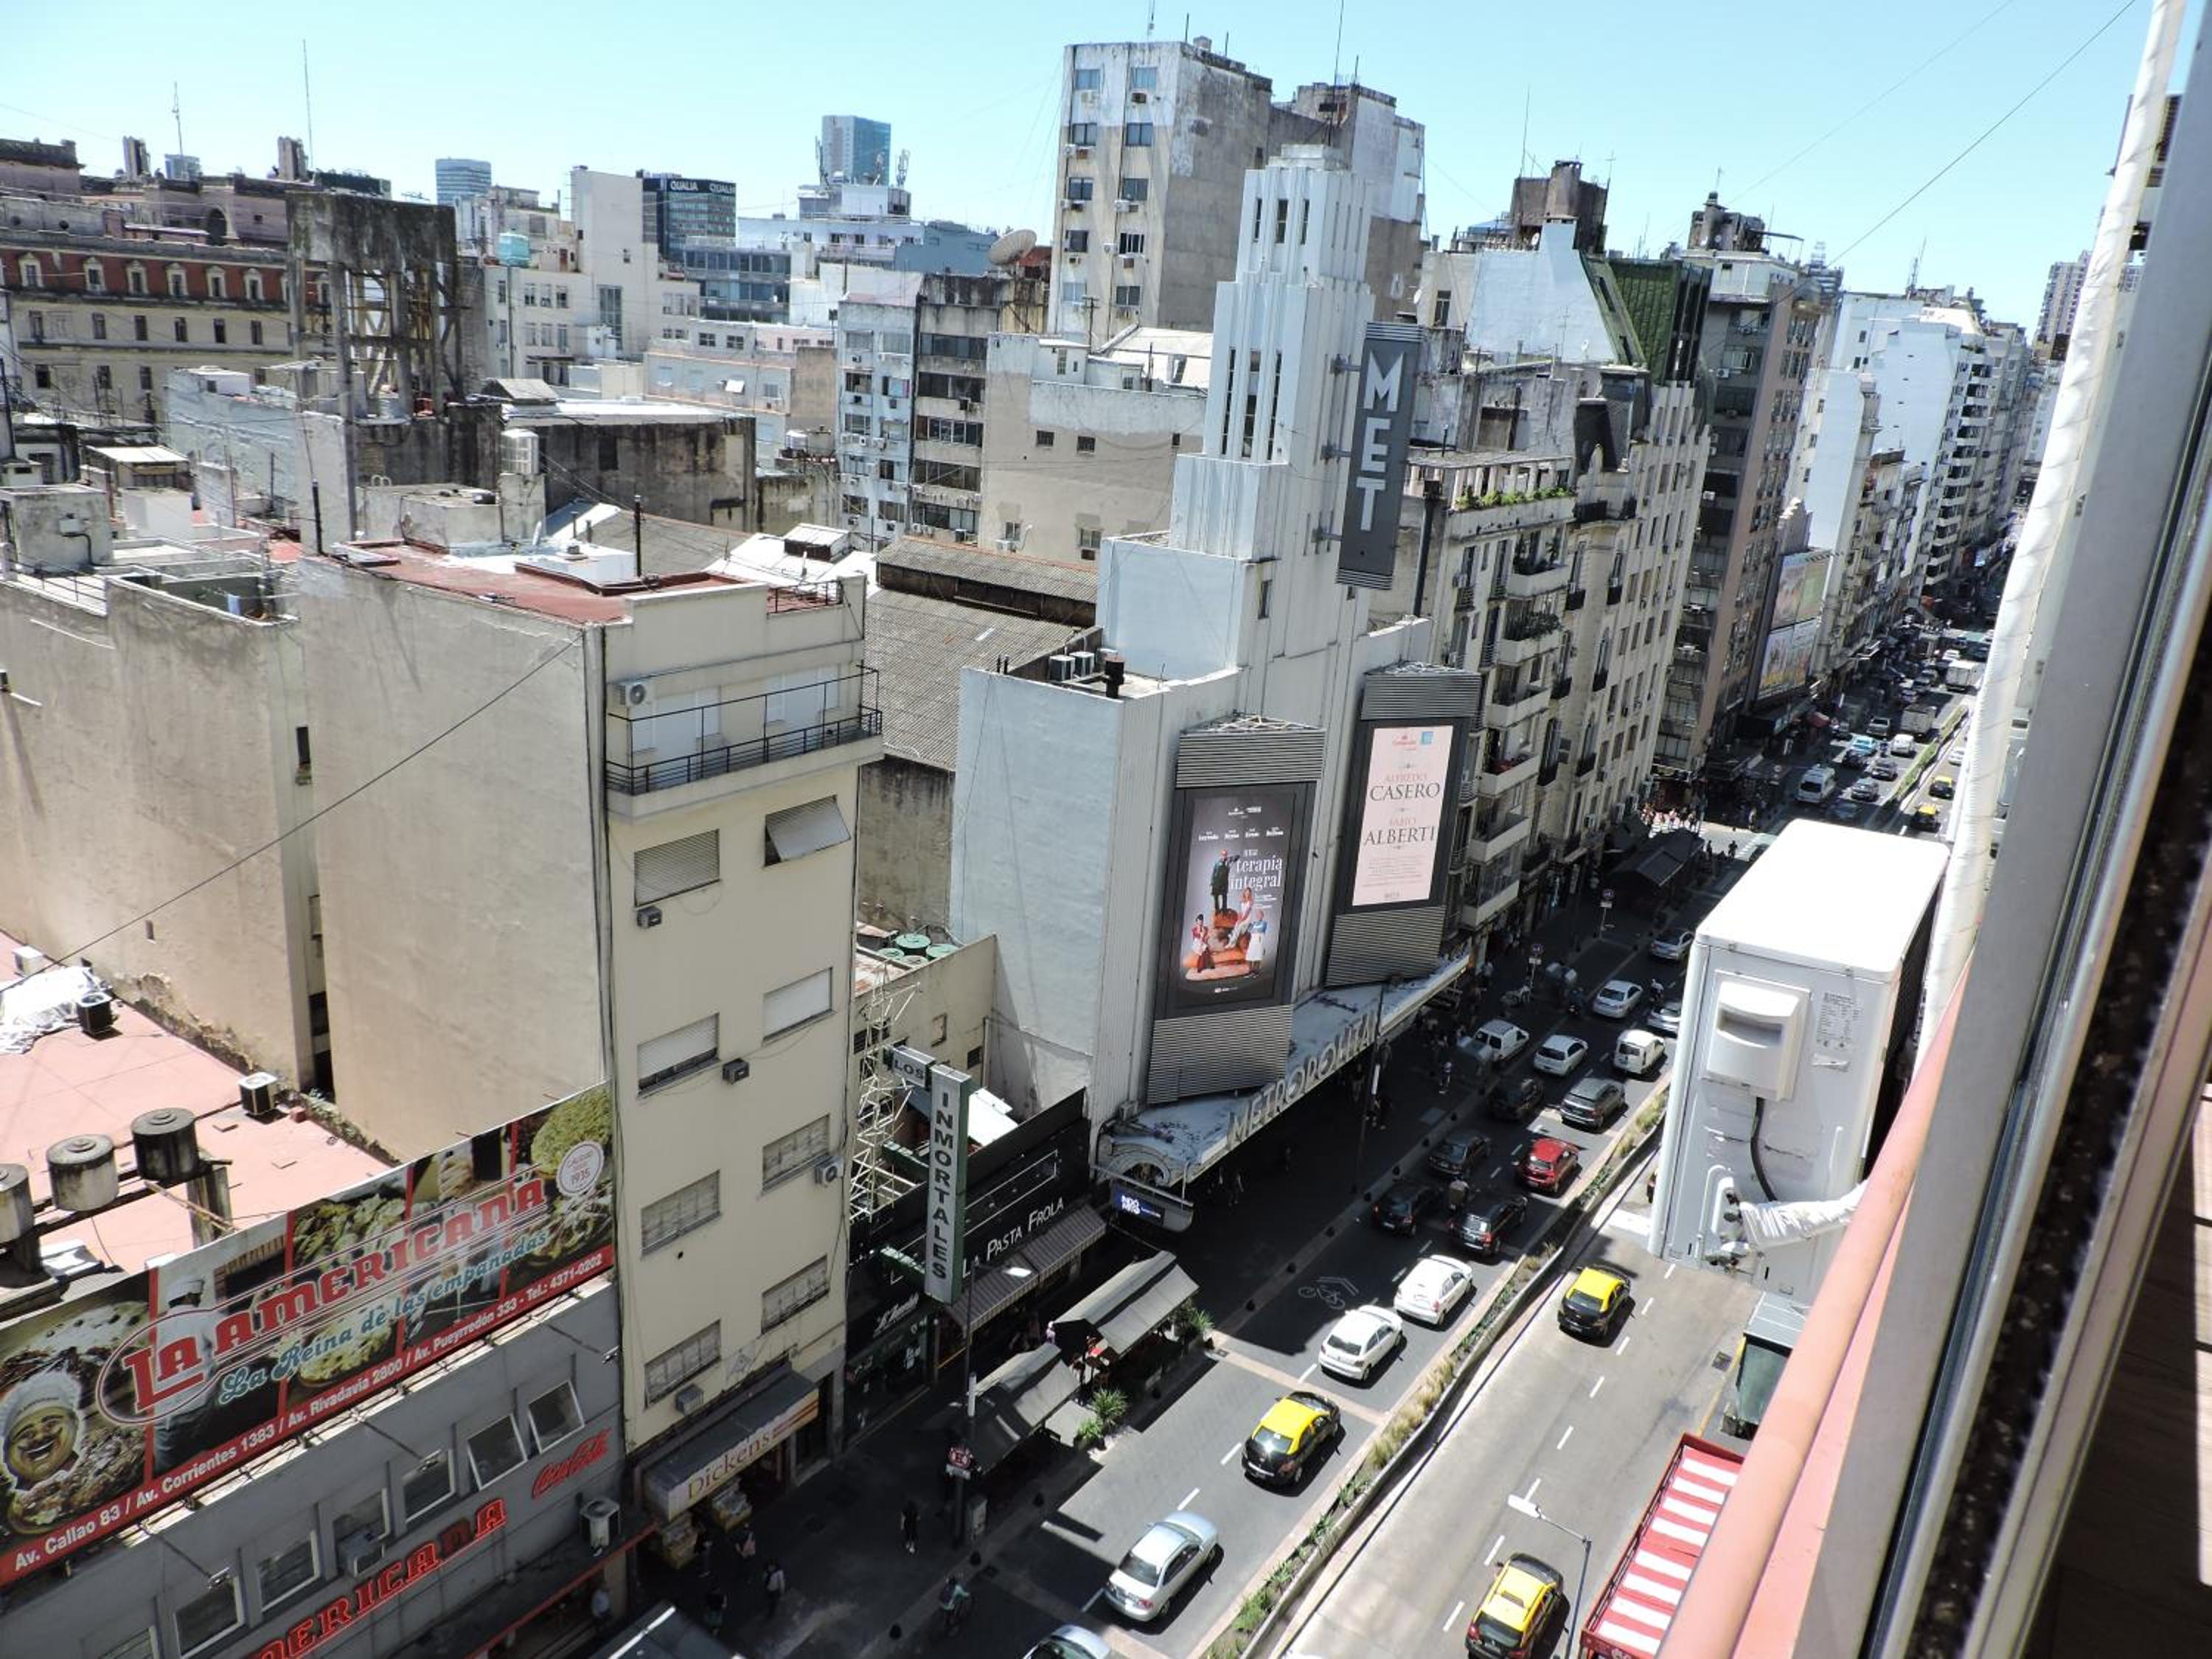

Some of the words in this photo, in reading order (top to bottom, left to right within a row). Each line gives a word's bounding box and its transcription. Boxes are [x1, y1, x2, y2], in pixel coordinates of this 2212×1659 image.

[670, 180, 699, 191] QUALIA
[1356, 350, 1404, 532] MET
[1368, 782, 1441, 801] CASERO
[1364, 826, 1436, 846] ALBERTI
[1228, 869, 1281, 891] integral
[1235, 855, 1283, 874] terapia
[894, 1059, 925, 1080] LOS
[932, 1092, 955, 1281] INMORTALES
[986, 1225, 1023, 1262] PASTA
[1028, 1196, 1064, 1233] FROLA
[218, 1365, 268, 1405] La
[271, 1327, 355, 1380] Reina
[361, 1307, 388, 1336] de
[394, 1295, 425, 1319] las
[431, 1231, 549, 1299] empanadas
[15, 1551, 41, 1571] Av.
[44, 1520, 96, 1554] Callao
[99, 1506, 122, 1527] 83
[136, 1488, 158, 1509] Av.
[161, 1446, 238, 1492] Corrientes
[240, 1424, 276, 1453] 1383
[288, 1410, 307, 1429] Av.
[309, 1375, 371, 1415] Rivadavia
[372, 1359, 403, 1385] 2800
[414, 1342, 432, 1360] Av.
[495, 1297, 518, 1316] 333
[549, 1253, 605, 1290] 4371-0202
[688, 1433, 770, 1500] Dickens
